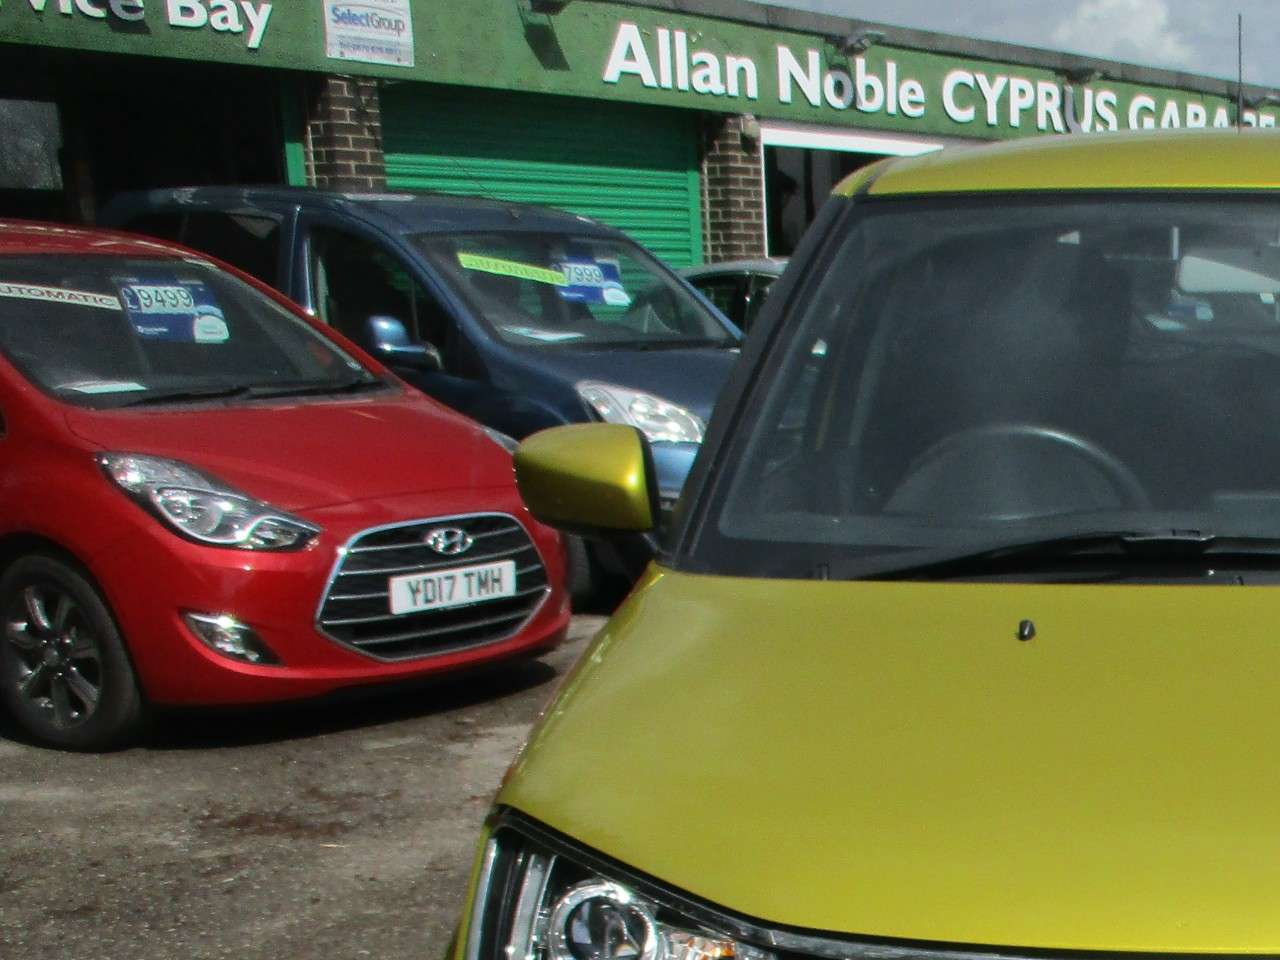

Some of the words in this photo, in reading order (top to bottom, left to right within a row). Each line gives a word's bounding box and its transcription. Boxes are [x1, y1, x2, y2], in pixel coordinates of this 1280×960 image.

[167, 0, 272, 49] Bay
[602, 22, 758, 100] Allan
[776, 44, 926, 118] Noble
[942, 70, 1118, 134] CYPRUS
[408, 575, 456, 606] YD17
[463, 567, 503, 598] TMH
